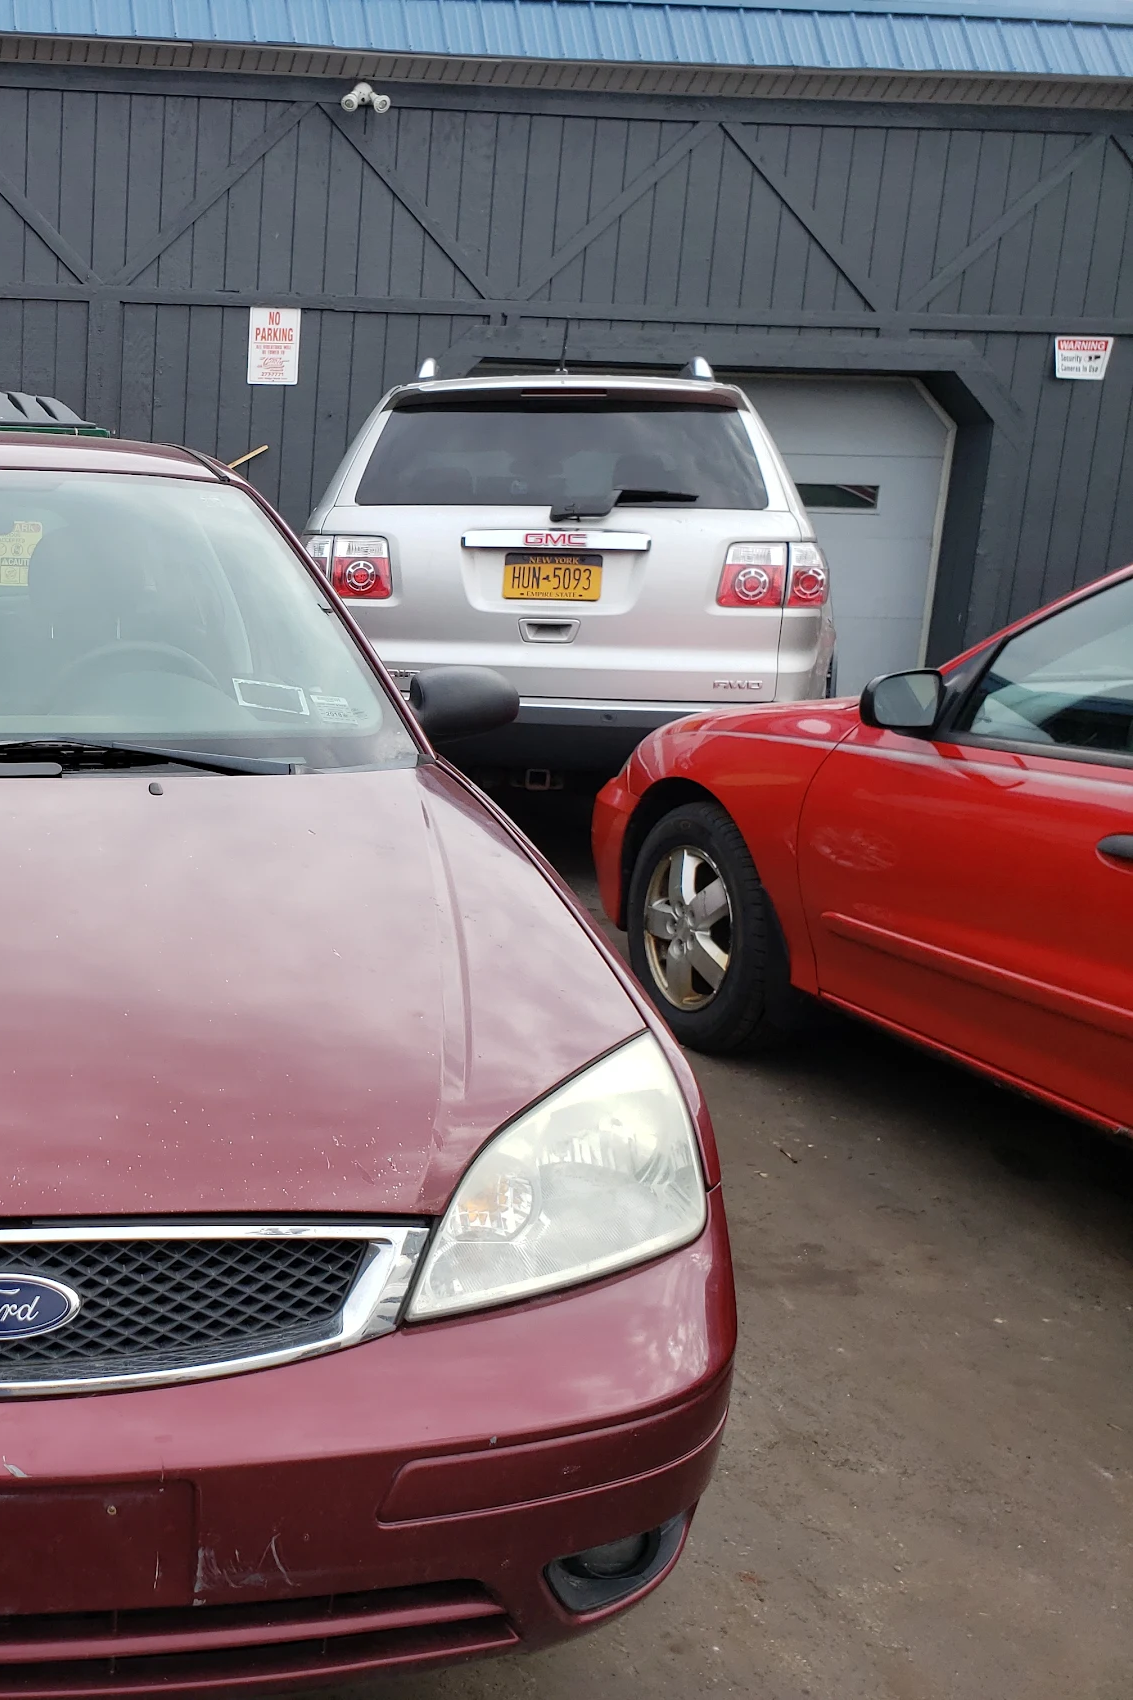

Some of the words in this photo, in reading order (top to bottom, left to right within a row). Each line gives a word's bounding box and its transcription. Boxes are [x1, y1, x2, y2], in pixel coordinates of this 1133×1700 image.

[268, 311, 281, 325] NO
[255, 327, 294, 342] PARKING
[1060, 340, 1105, 350] WARNING
[1061, 353, 1082, 363] Security
[1061, 364, 1081, 373] Cameras
[1089, 365, 1099, 373] Use
[523, 533, 587, 547] GMC
[529, 556, 551, 564] NEW
[554, 556, 579, 565] YORK
[511, 566, 541, 590] HUN
[552, 567, 592, 591] 5093
